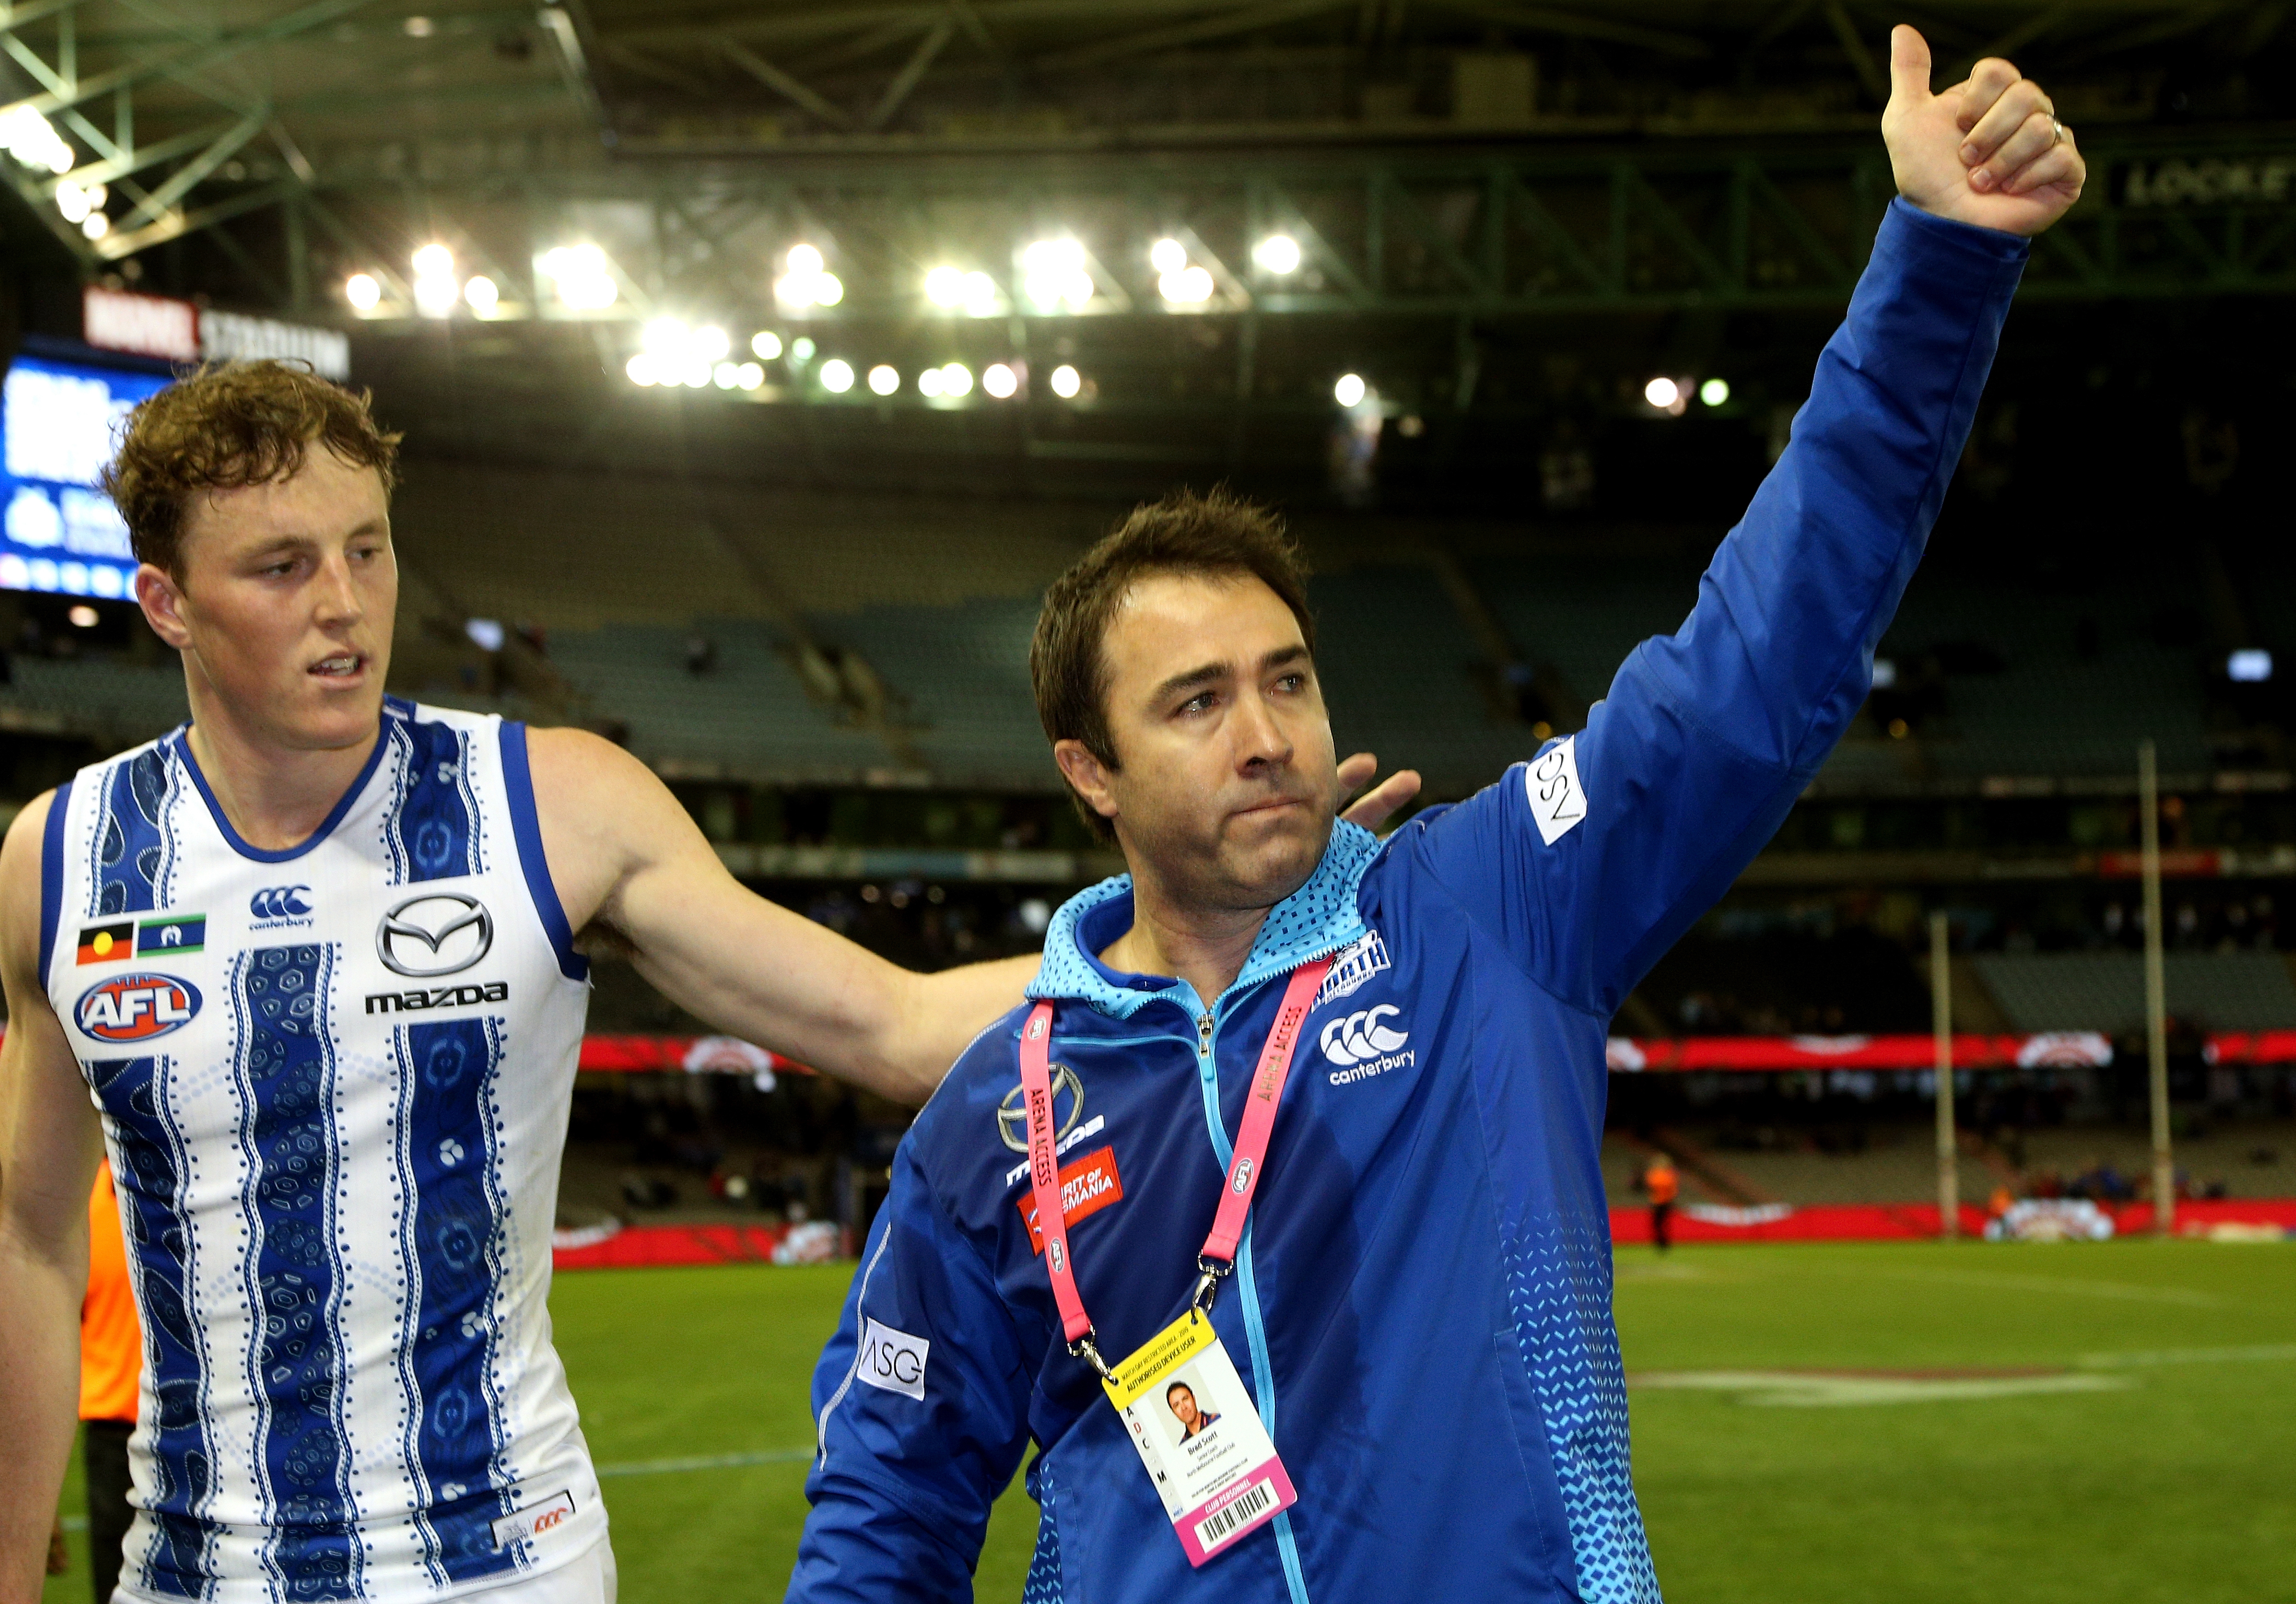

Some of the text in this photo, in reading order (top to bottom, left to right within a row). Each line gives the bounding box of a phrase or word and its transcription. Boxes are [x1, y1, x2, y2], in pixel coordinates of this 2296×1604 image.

[249, 916, 314, 930] canterbury
[82, 986, 191, 1029] AFL
[365, 981, 509, 1014] mazda
[1257, 1006, 1302, 1102] ARENA ACCESS
[1329, 1050, 1415, 1086] canterbury
[1030, 1088, 1052, 1187] ARENA ACCESS
[1087, 1167, 1102, 1182] OF
[1233, 1162, 1251, 1192] AFL
[1122, 1365, 1137, 1380] MATCH
[1135, 1361, 1144, 1371] DAY
[1143, 1344, 1167, 1363] RESTRICTED
[1166, 1335, 1178, 1348] AREA
[1179, 1327, 1188, 1338] 2019
[1127, 1336, 1196, 1394] AUTHORISED DEVICE USER
[1126, 1406, 1134, 1418] A
[1133, 1422, 1142, 1434] D
[1142, 1438, 1150, 1449] C
[1187, 1431, 1218, 1455] Brad Scott
[1157, 1470, 1167, 1484] M
[1205, 1478, 1252, 1514] CLUB PERSONNEL
